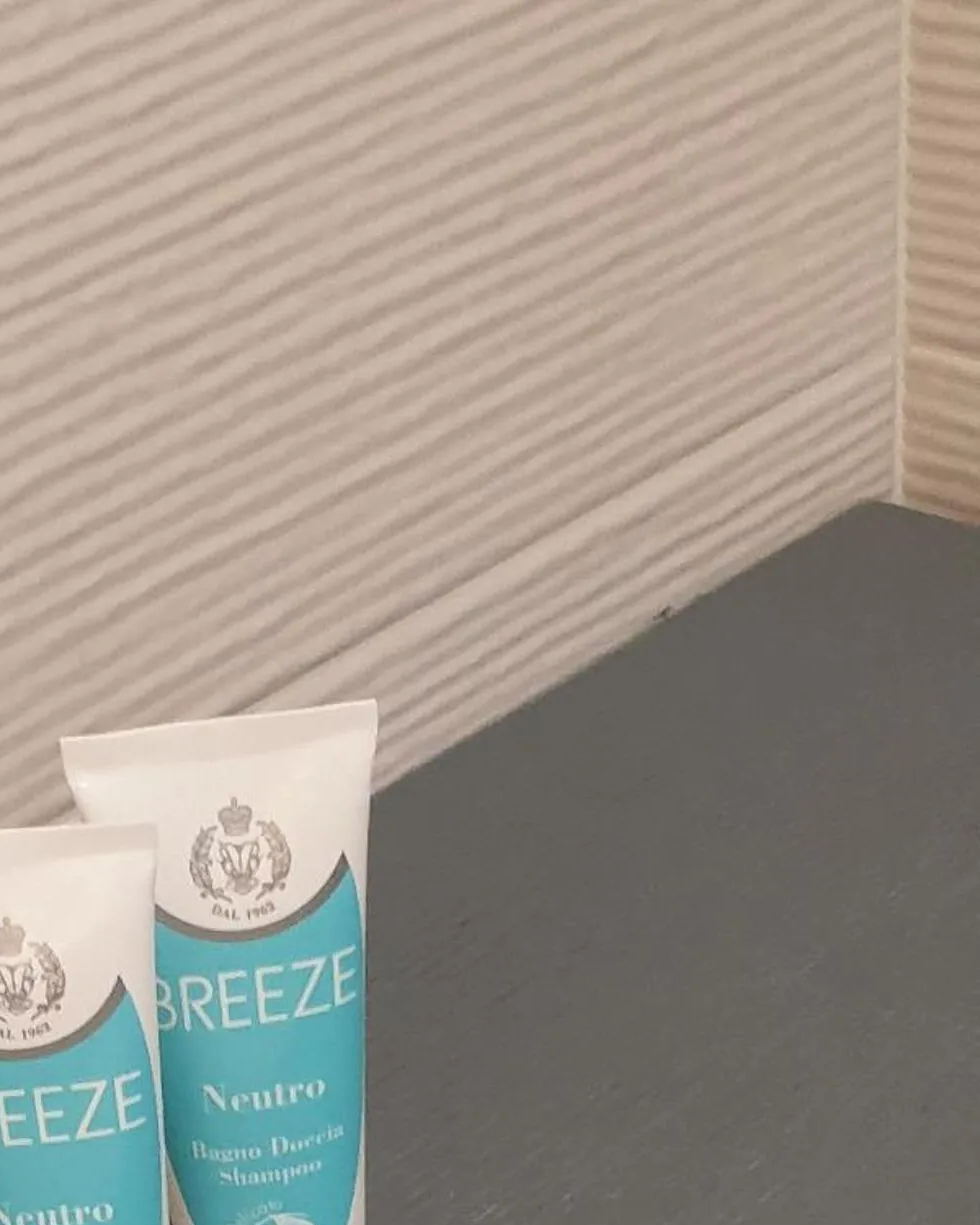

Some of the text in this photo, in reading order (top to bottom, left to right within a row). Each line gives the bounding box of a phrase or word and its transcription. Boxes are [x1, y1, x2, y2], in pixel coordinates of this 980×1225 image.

[212, 903, 240, 920] DAL
[155, 945, 357, 1032] BREEZE
[202, 1078, 326, 1113] Neutro
[191, 1123, 345, 1163] Bagno Doccia
[219, 1159, 323, 1186] Shampoo
